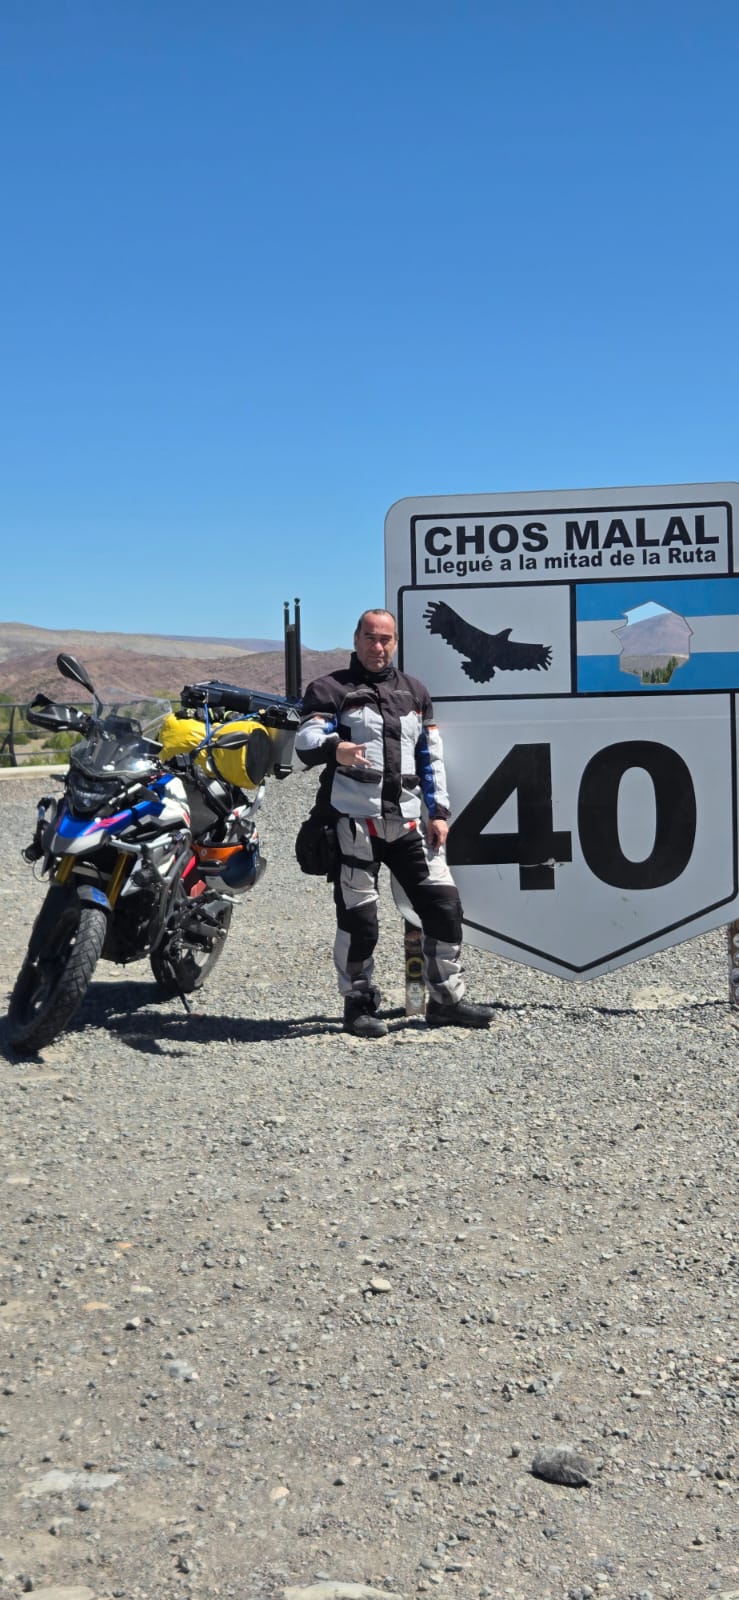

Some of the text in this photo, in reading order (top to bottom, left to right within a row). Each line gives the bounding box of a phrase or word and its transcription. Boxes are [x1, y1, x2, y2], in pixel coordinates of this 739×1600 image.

[424, 515, 720, 557] CHOS MALAL
[424, 547, 717, 576] Llegué a la mitad de la Ruta
[446, 740, 697, 890] 40
